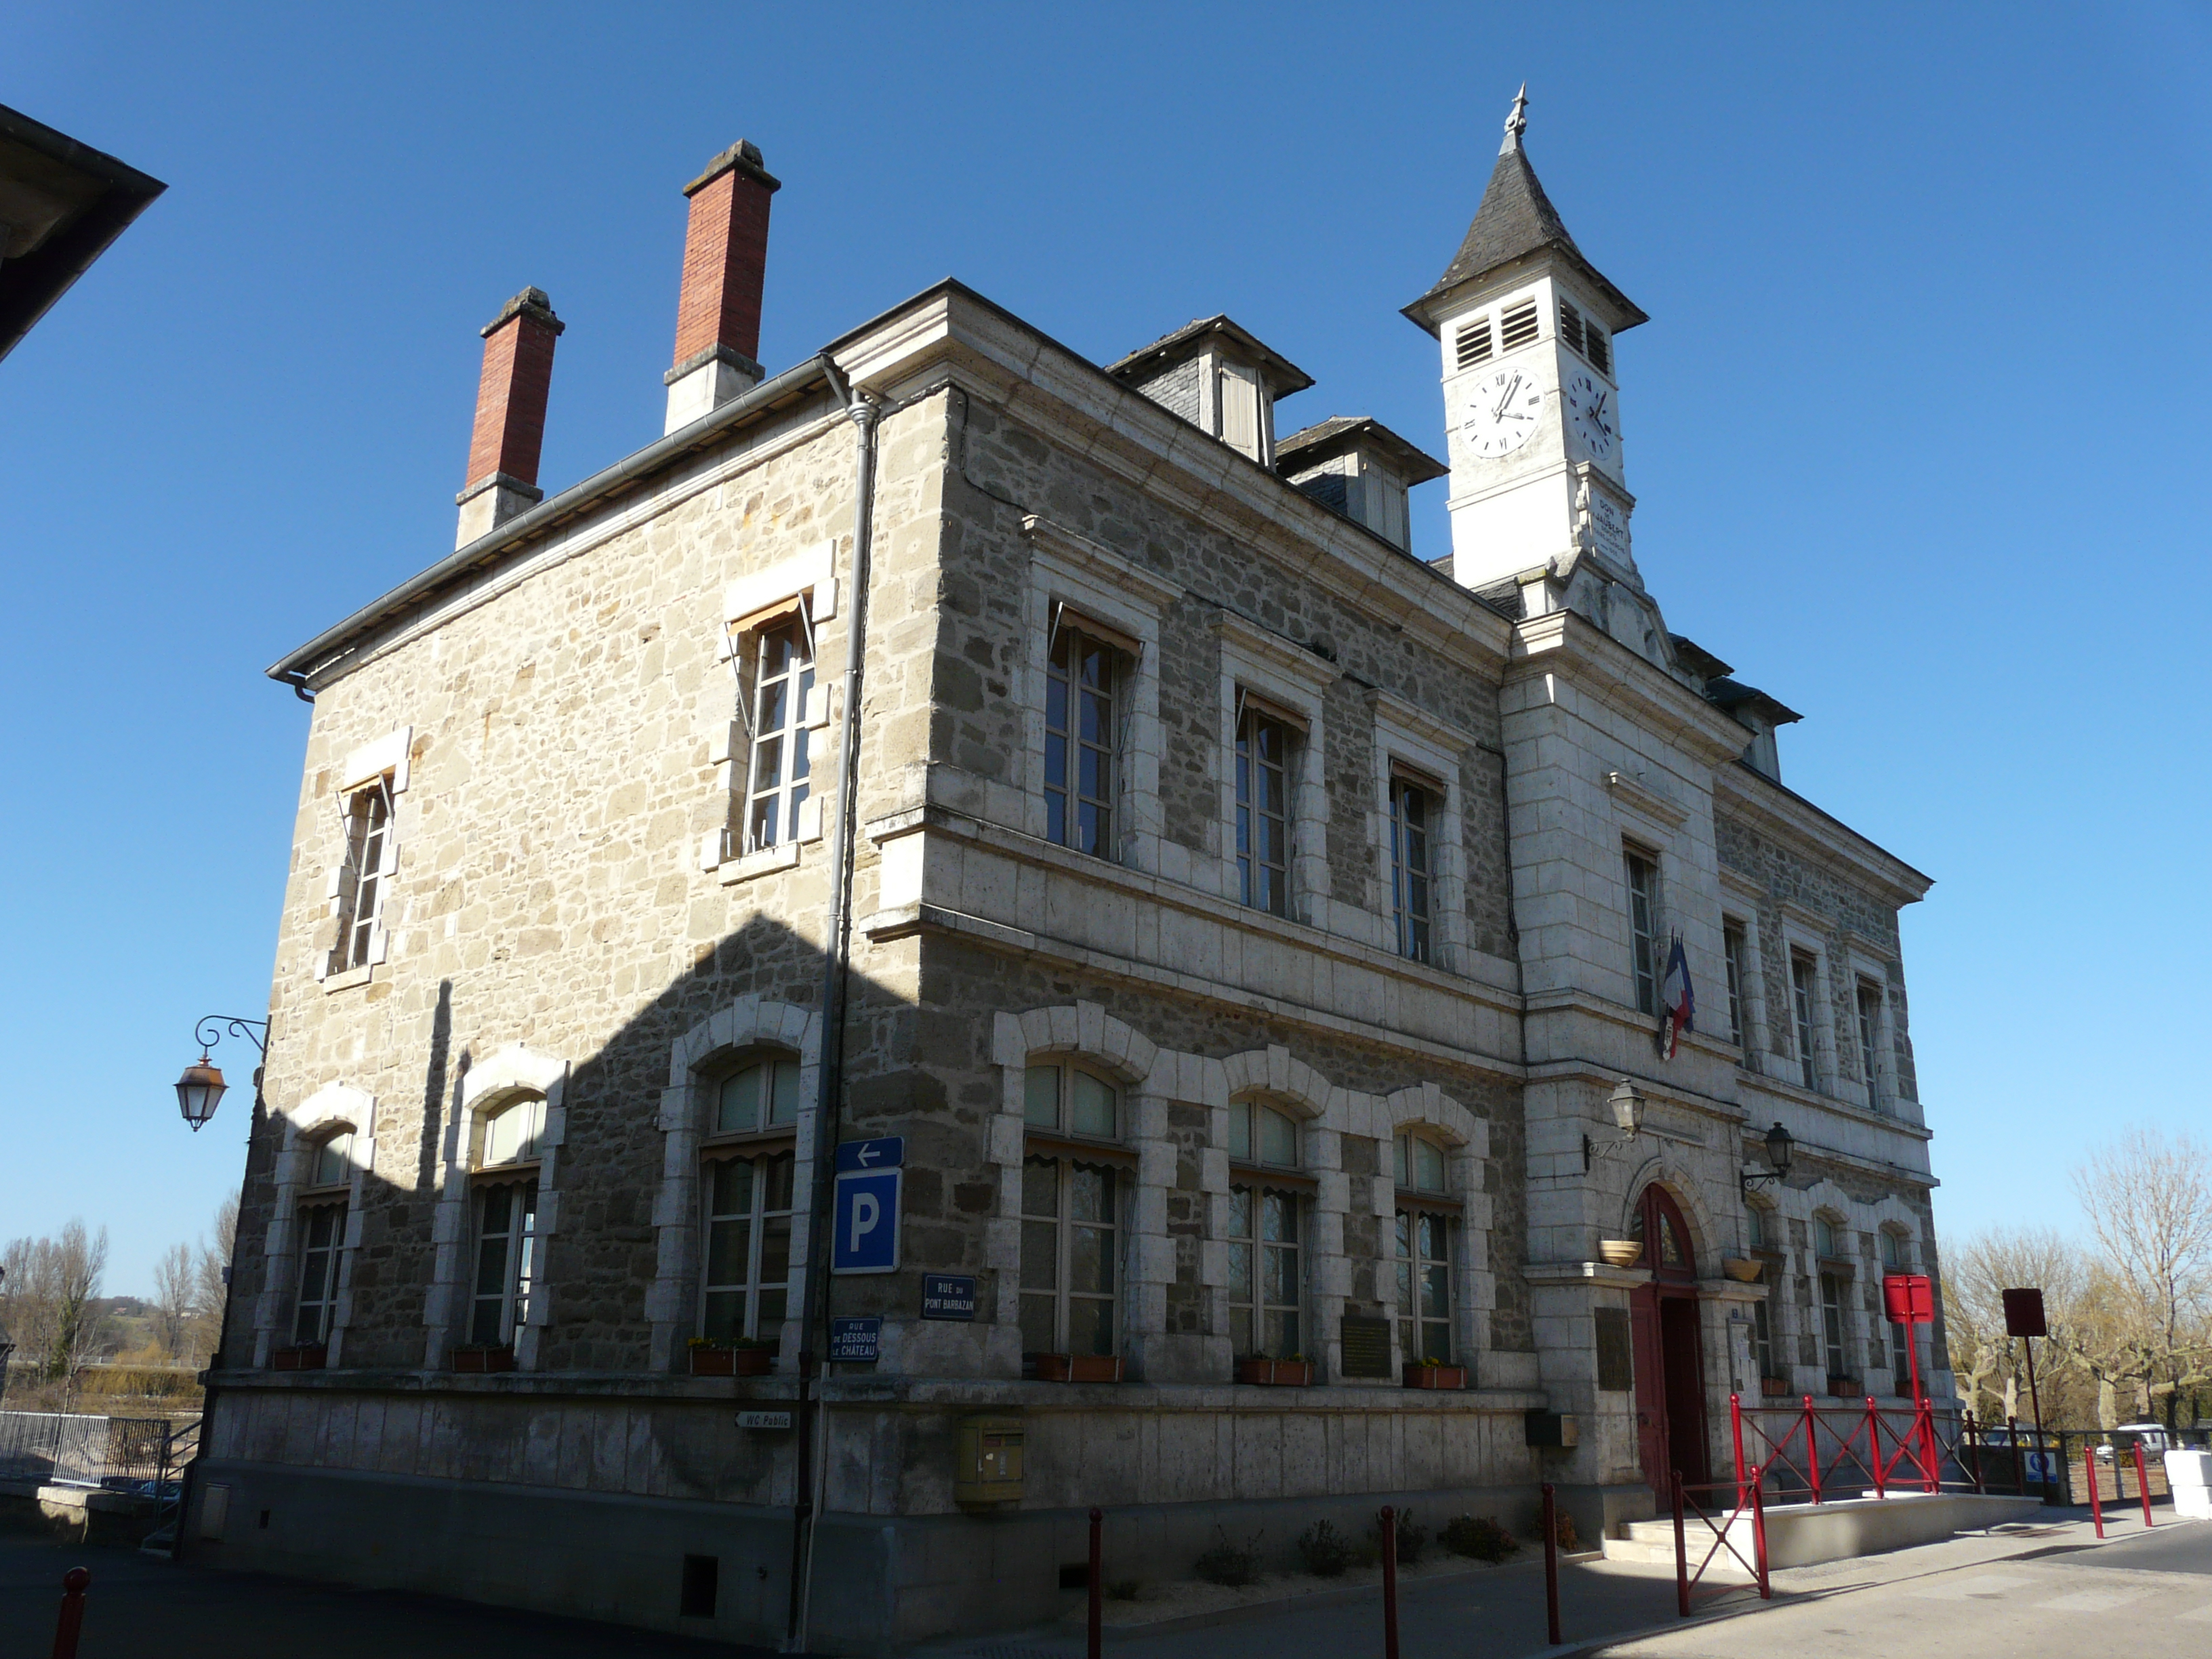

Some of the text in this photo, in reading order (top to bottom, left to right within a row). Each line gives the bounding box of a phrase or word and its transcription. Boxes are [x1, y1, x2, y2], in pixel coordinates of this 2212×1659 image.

[1495, 373, 1505, 388] XII
[850, 1192, 880, 1253] P
[938, 1282, 964, 1294] RUE DU
[925, 1298, 974, 1311] PONT BARBAZAN
[848, 1322, 864, 1330] RUE
[842, 1332, 877, 1343] DESSOUS
[832, 1344, 876, 1356] LE CHÂTEAU
[747, 1414, 788, 1426] WC Public
